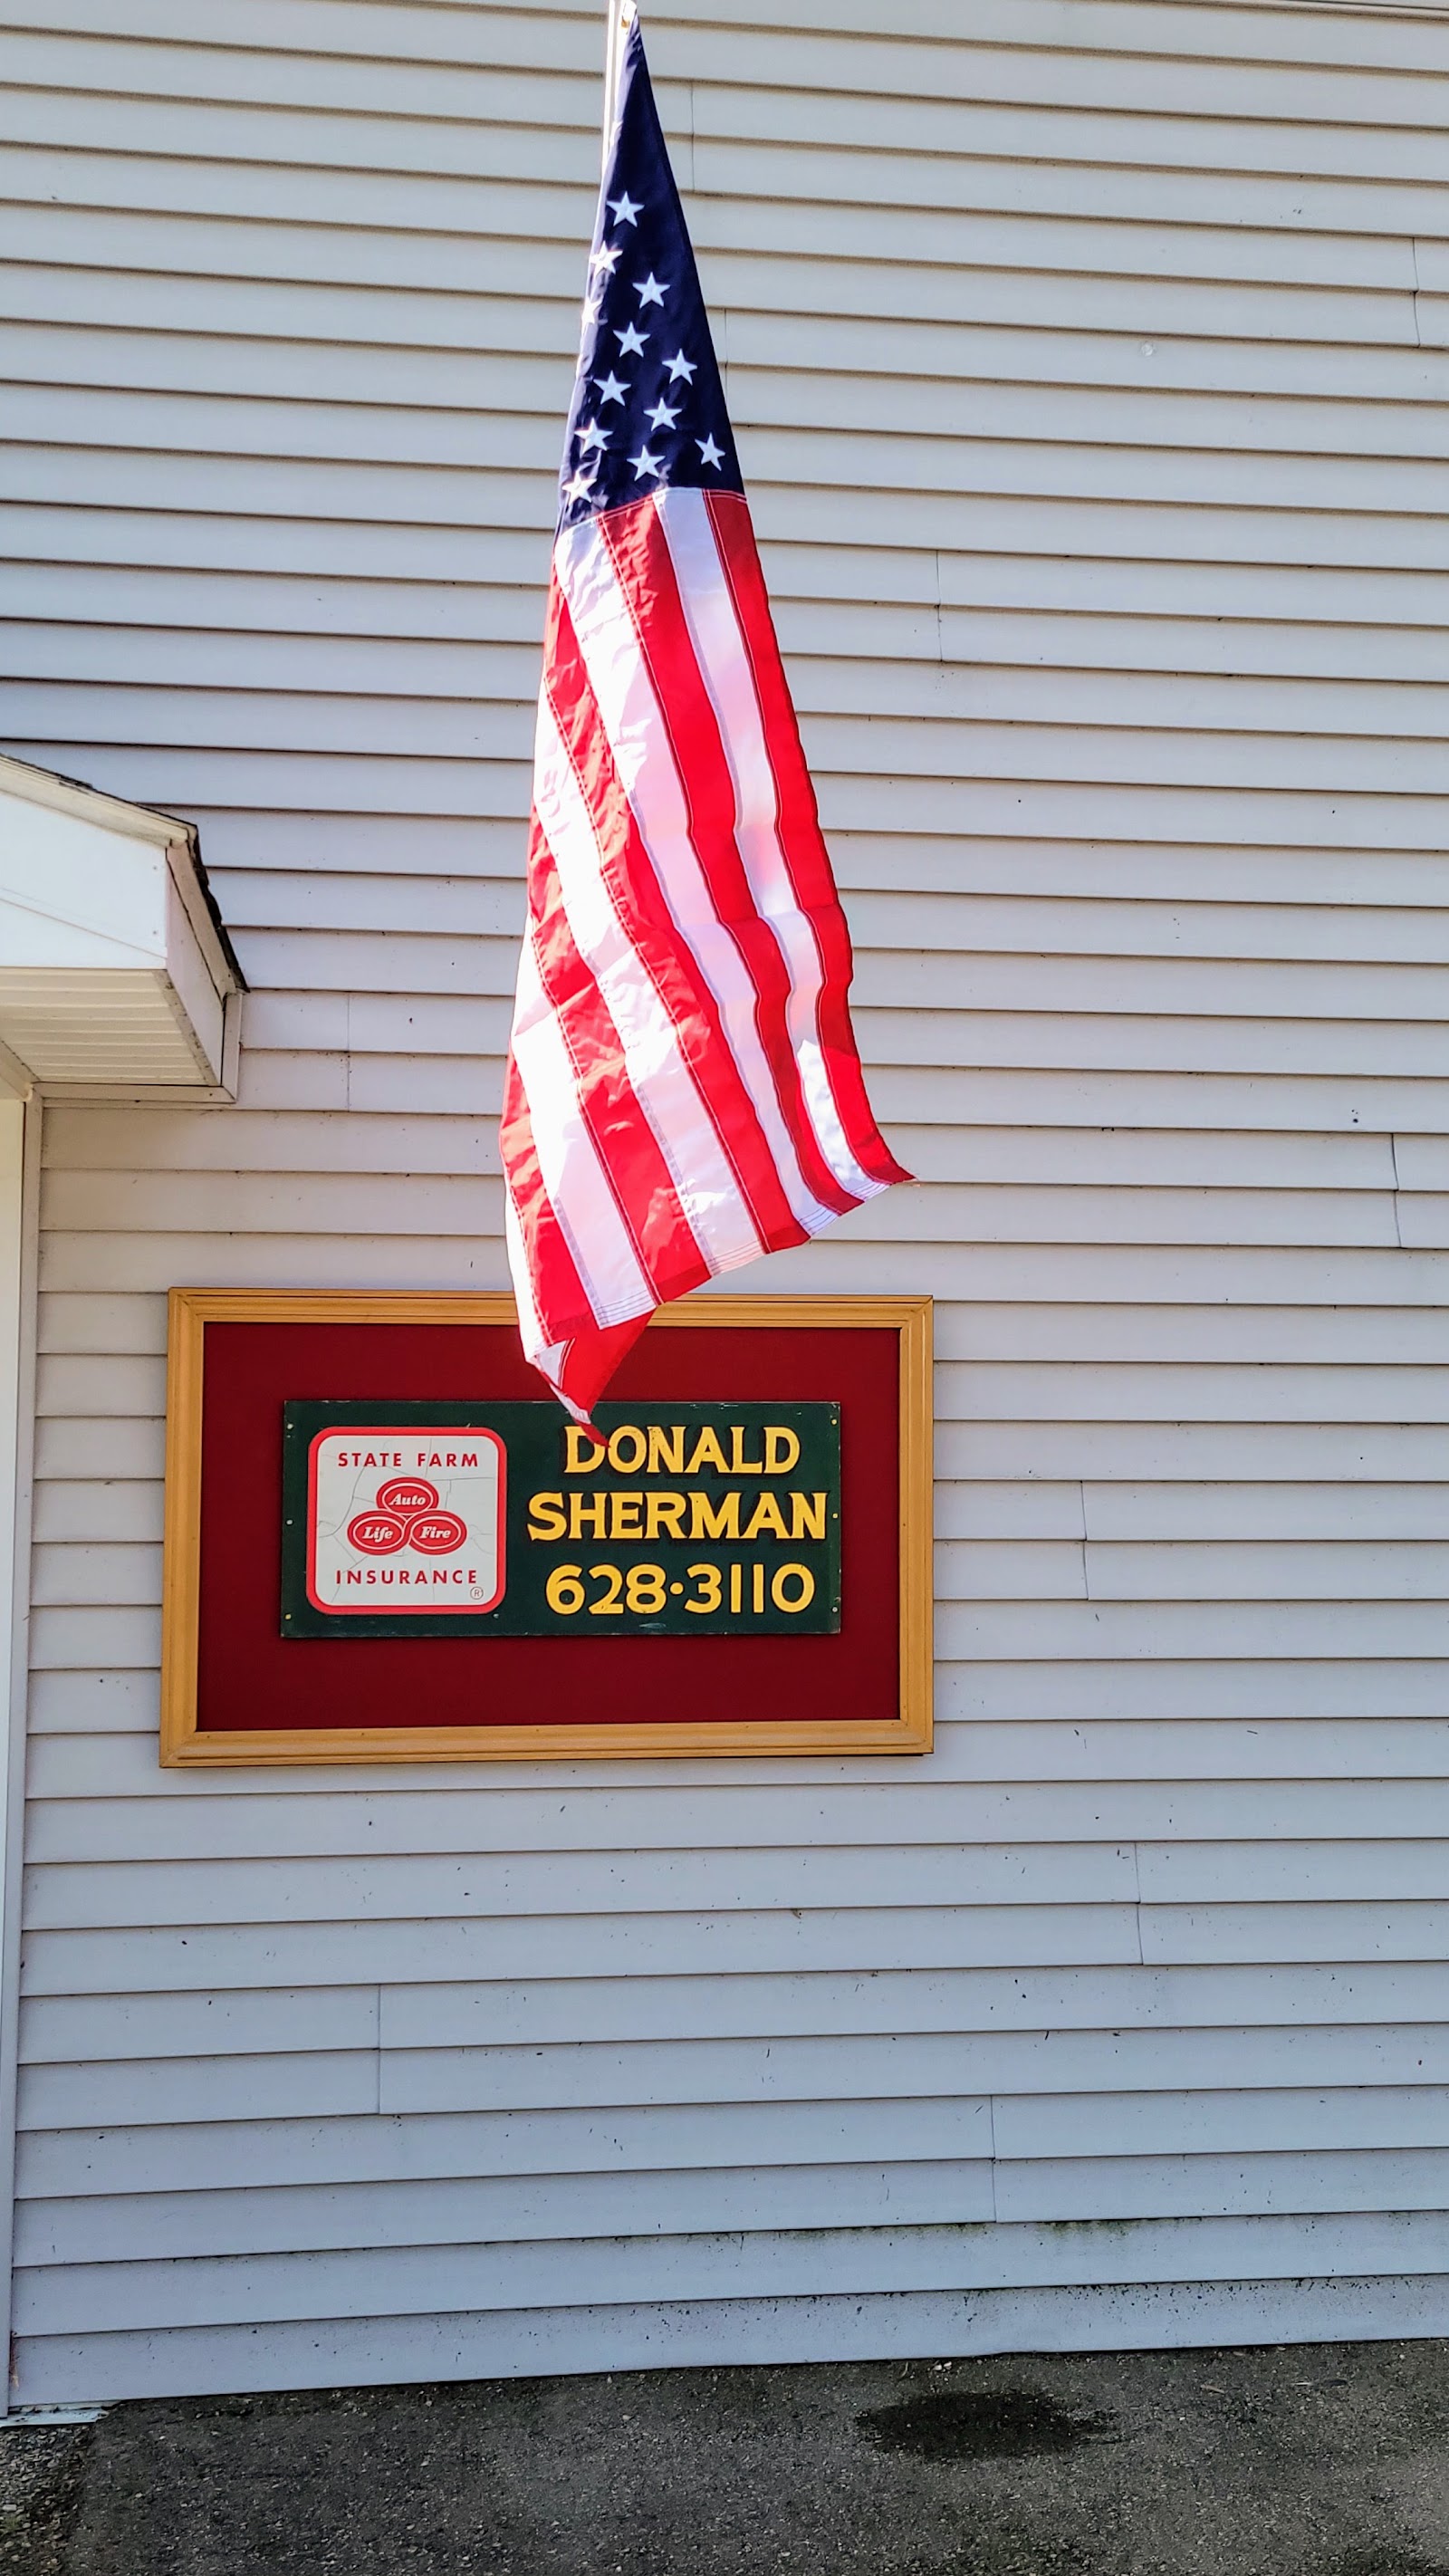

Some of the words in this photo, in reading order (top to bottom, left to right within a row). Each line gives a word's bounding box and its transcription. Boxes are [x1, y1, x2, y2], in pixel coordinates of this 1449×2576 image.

[563, 1425, 801, 1474] DONALD
[337, 1452, 403, 1467] STATE
[417, 1452, 479, 1467] FARM
[389, 1494, 427, 1506] Auto
[527, 1491, 828, 1541] SHERMAN
[361, 1525, 394, 1543] Life
[419, 1525, 452, 1539] Fire
[336, 1570, 477, 1585] INSURANCE
